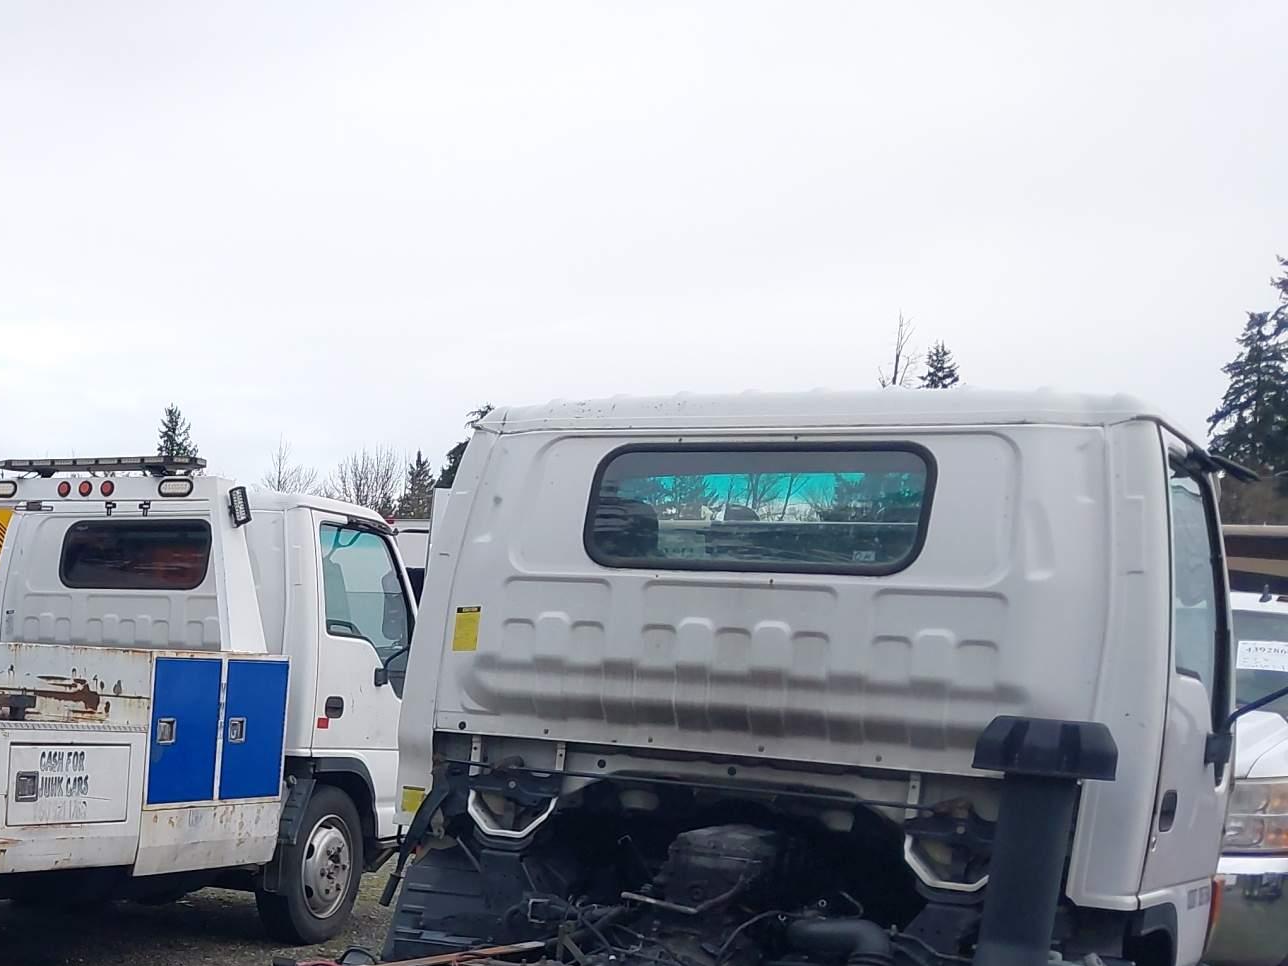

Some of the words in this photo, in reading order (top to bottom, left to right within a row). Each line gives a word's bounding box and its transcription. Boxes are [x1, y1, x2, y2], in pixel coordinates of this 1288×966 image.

[40, 751, 64, 772] CASH
[66, 751, 85, 772] FOR
[38, 776, 64, 798] JUNK
[65, 774, 89, 797] CARS
